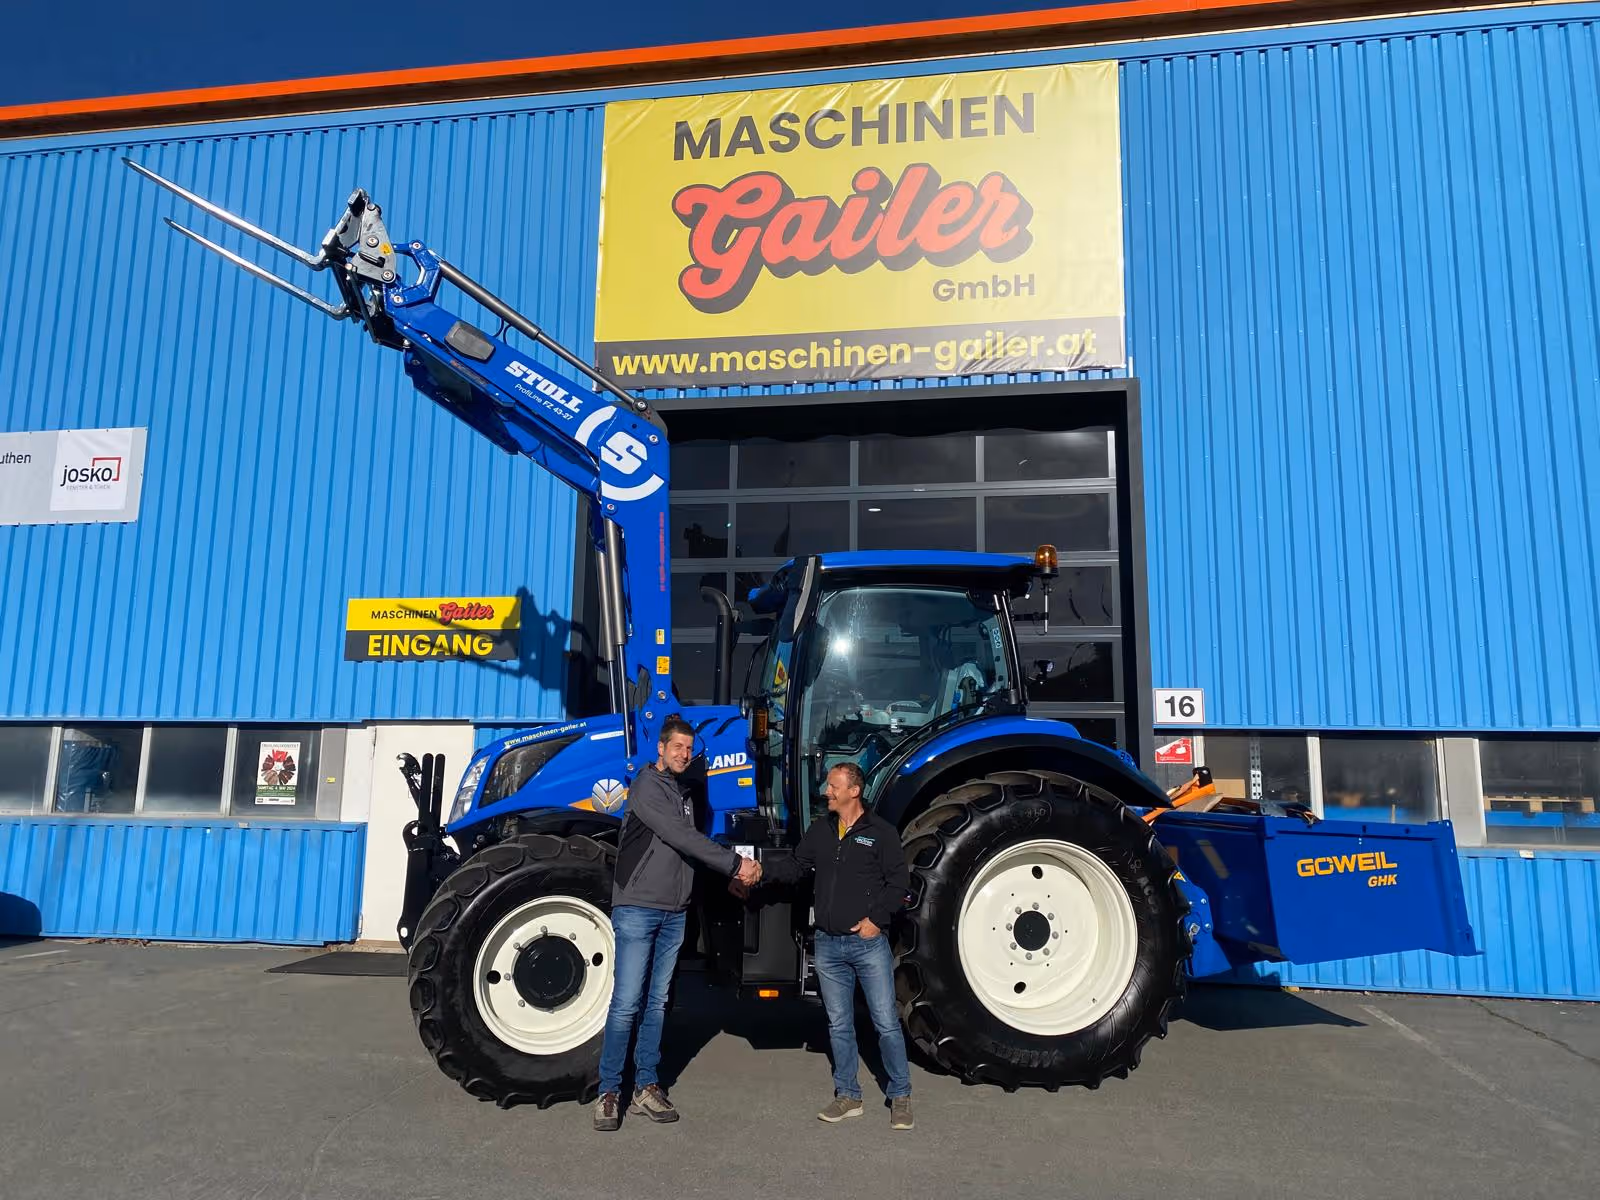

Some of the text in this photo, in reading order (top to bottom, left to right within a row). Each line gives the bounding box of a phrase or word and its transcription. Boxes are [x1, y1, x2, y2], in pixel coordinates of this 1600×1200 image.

[672, 92, 1035, 161] MASCHINEN
[672, 162, 1034, 314] Gailer
[932, 273, 1035, 302] GmbH
[612, 329, 1098, 376] www.maschinen-gailer.at
[505, 360, 583, 413] STOLL
[542, 400, 554, 410] FZ
[60, 465, 113, 487] josko
[370, 602, 494, 625] MASCHINEN Gailer
[367, 633, 493, 657] EINGANG
[1164, 695, 1196, 718] 16
[708, 752, 747, 769] AND
[1367, 873, 1398, 888] GHK
